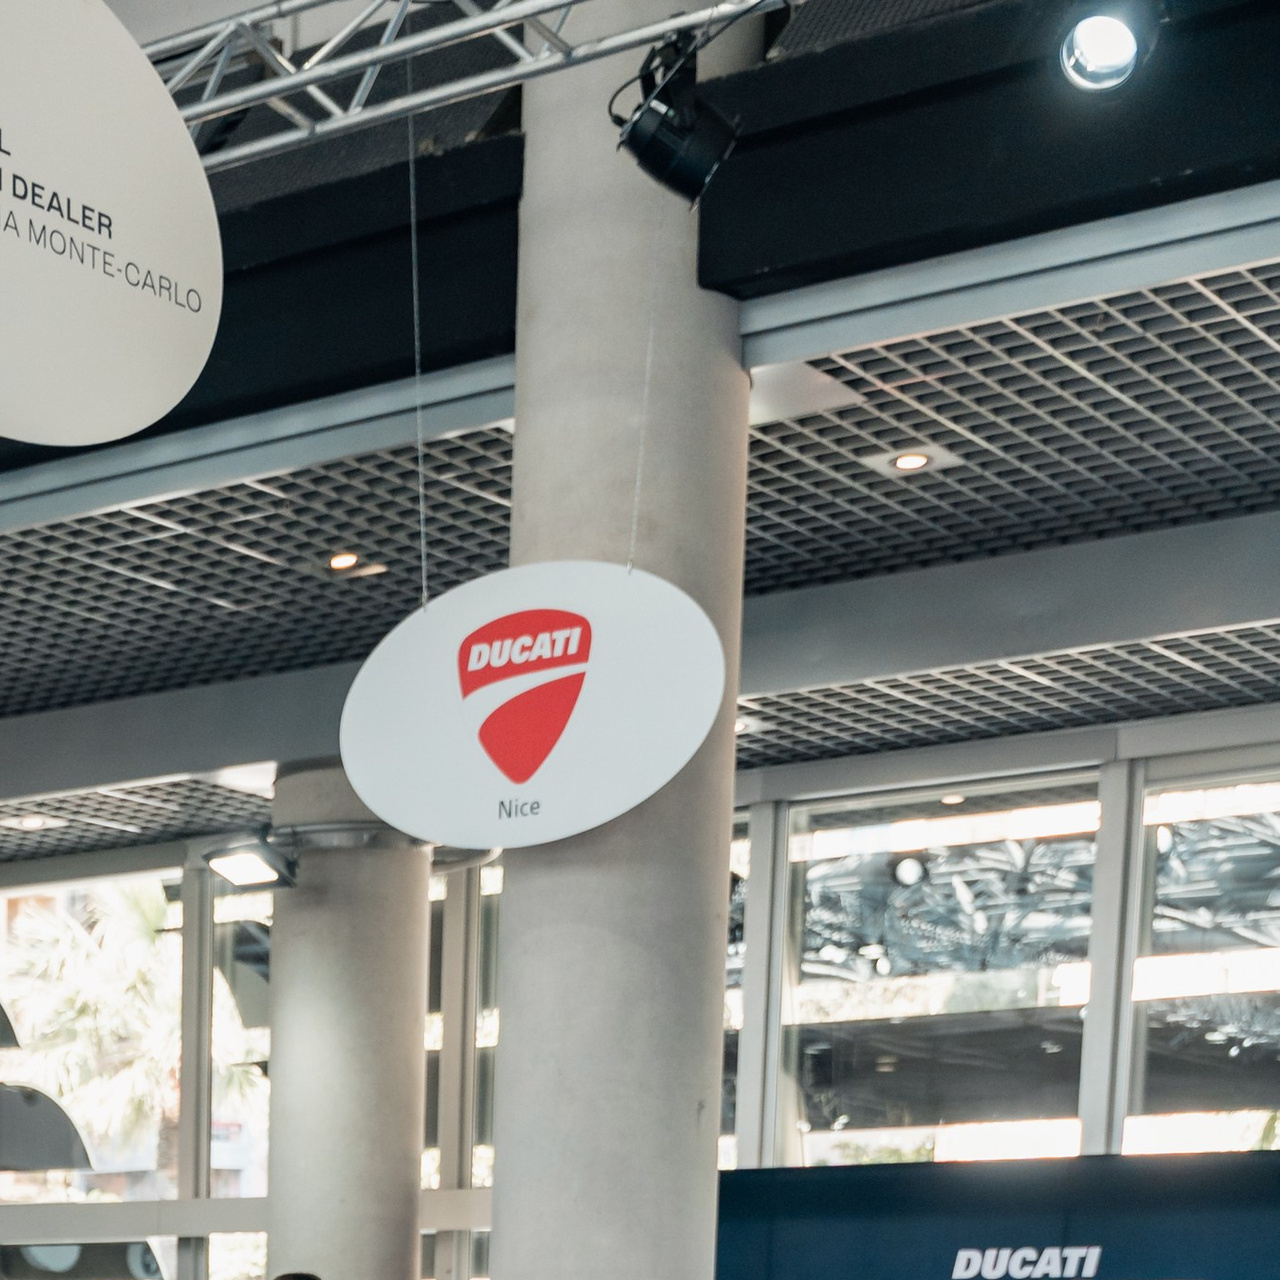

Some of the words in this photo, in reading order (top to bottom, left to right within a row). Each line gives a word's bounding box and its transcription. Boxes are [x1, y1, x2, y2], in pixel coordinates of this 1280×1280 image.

[11, 172, 114, 239] DEALER
[27, 217, 202, 313] MONTE-CARLO
[467, 627, 582, 673] DUCATI
[497, 800, 540, 820] Nice
[951, 1245, 1102, 1280] DUCATI
